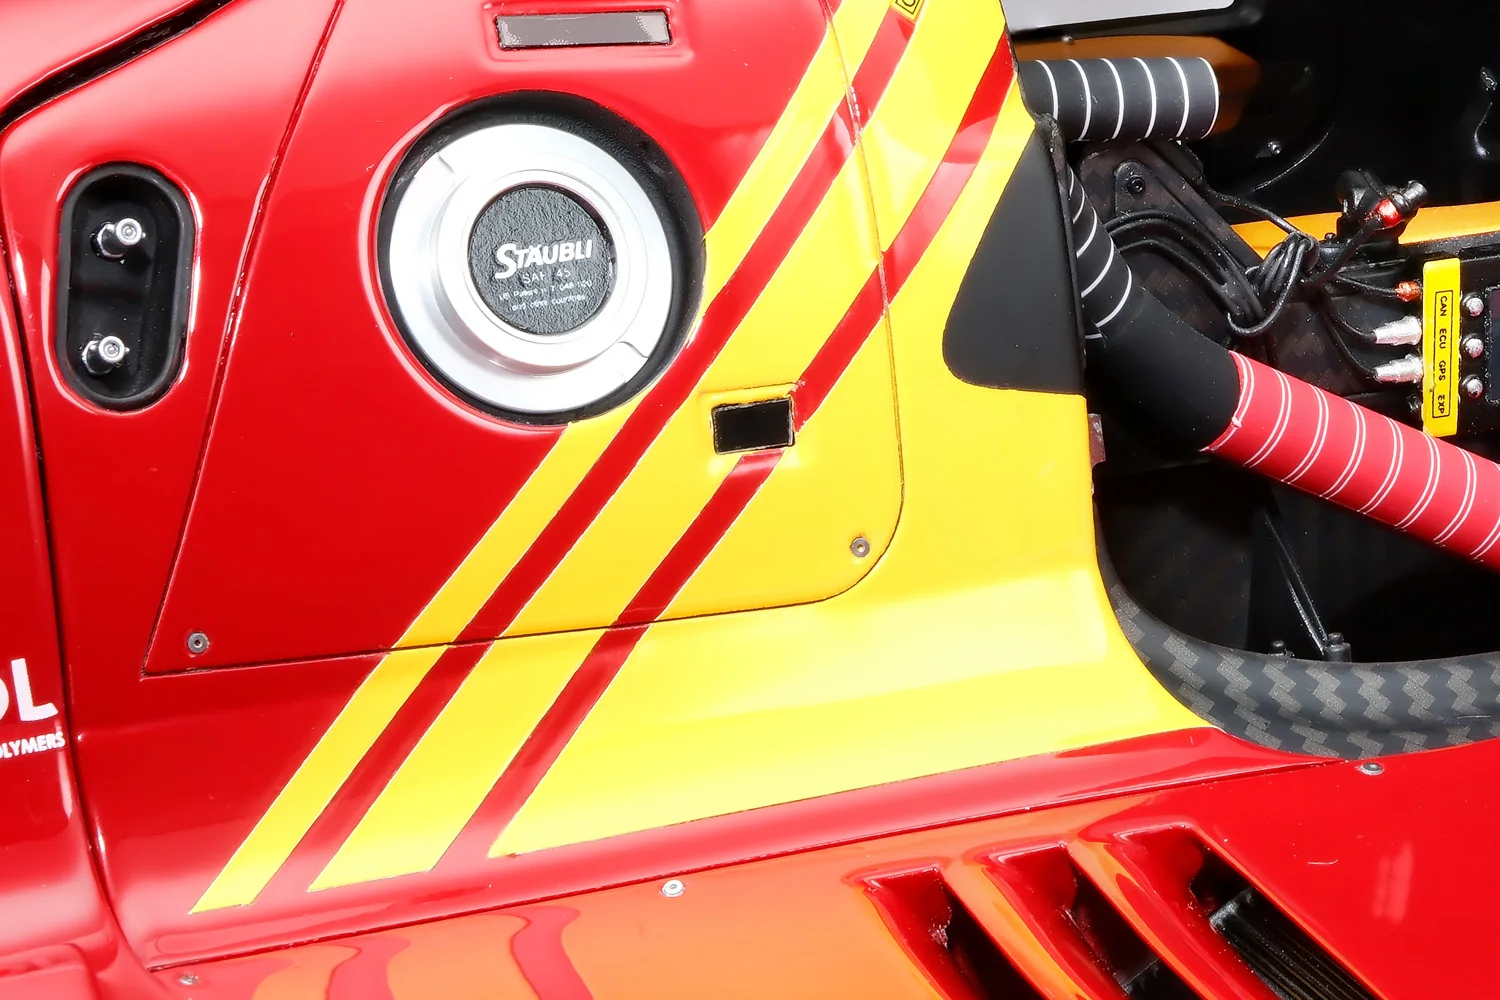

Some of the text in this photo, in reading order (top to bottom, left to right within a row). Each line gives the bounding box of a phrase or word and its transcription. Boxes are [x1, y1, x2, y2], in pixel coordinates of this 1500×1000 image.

[1437, 296, 1448, 414] CAN ECU GPS EXP
